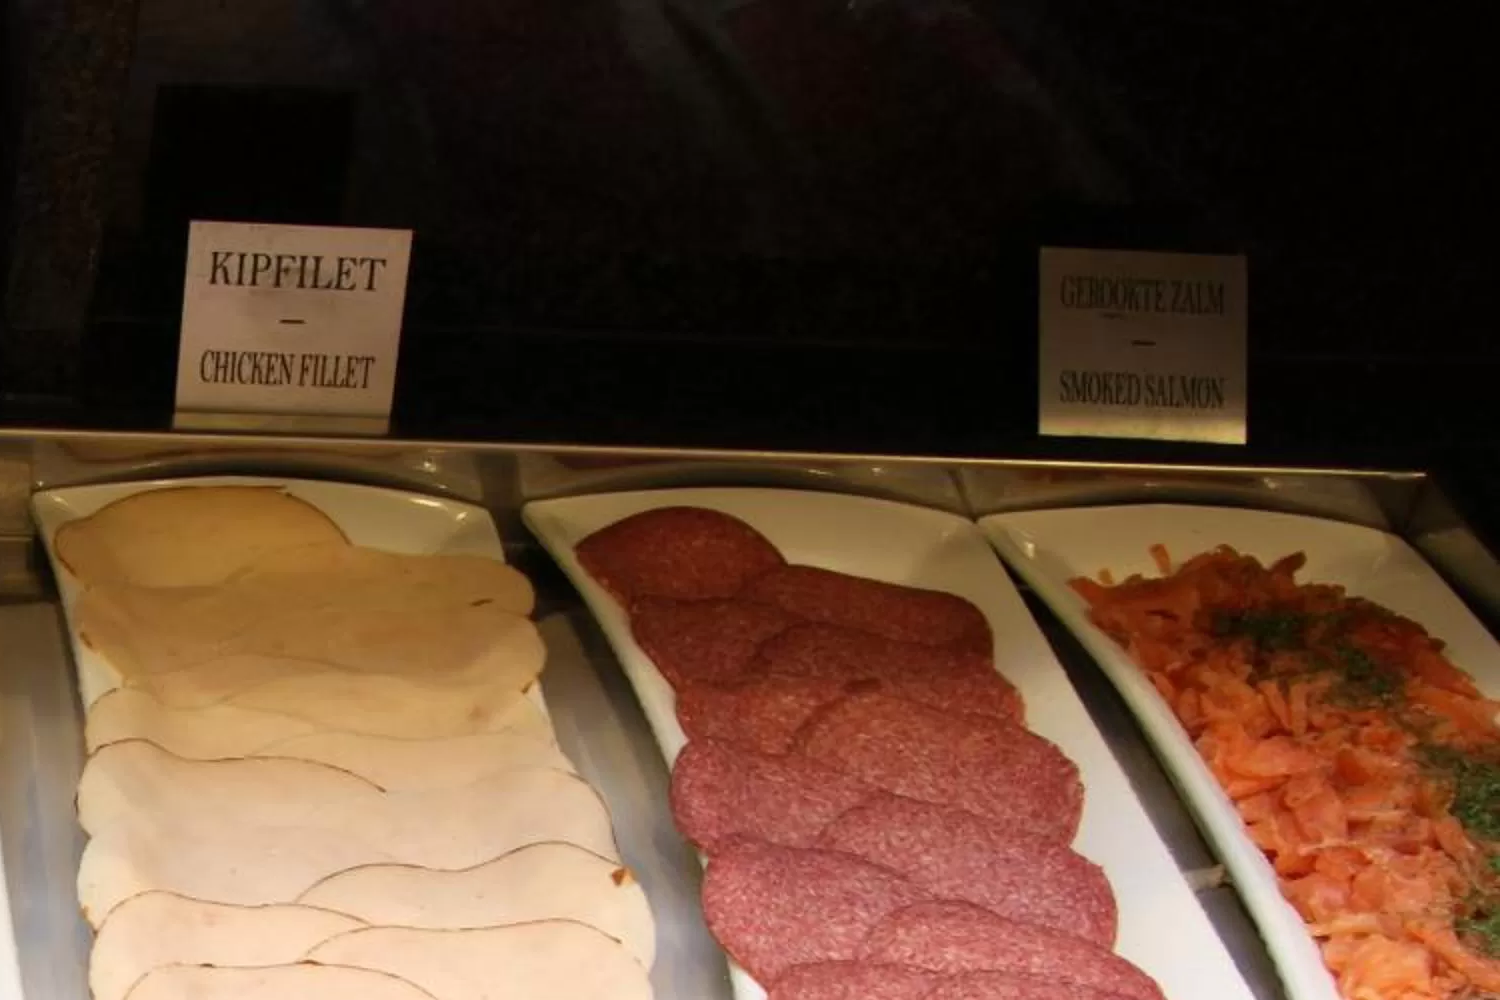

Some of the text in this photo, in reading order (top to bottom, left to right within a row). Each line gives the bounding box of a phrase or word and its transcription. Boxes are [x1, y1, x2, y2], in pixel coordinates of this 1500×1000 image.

[208, 251, 388, 292] KIPFILET
[199, 349, 376, 389] CHICKEN FILLET
[1059, 370, 1225, 409] SMOKED SALMON
